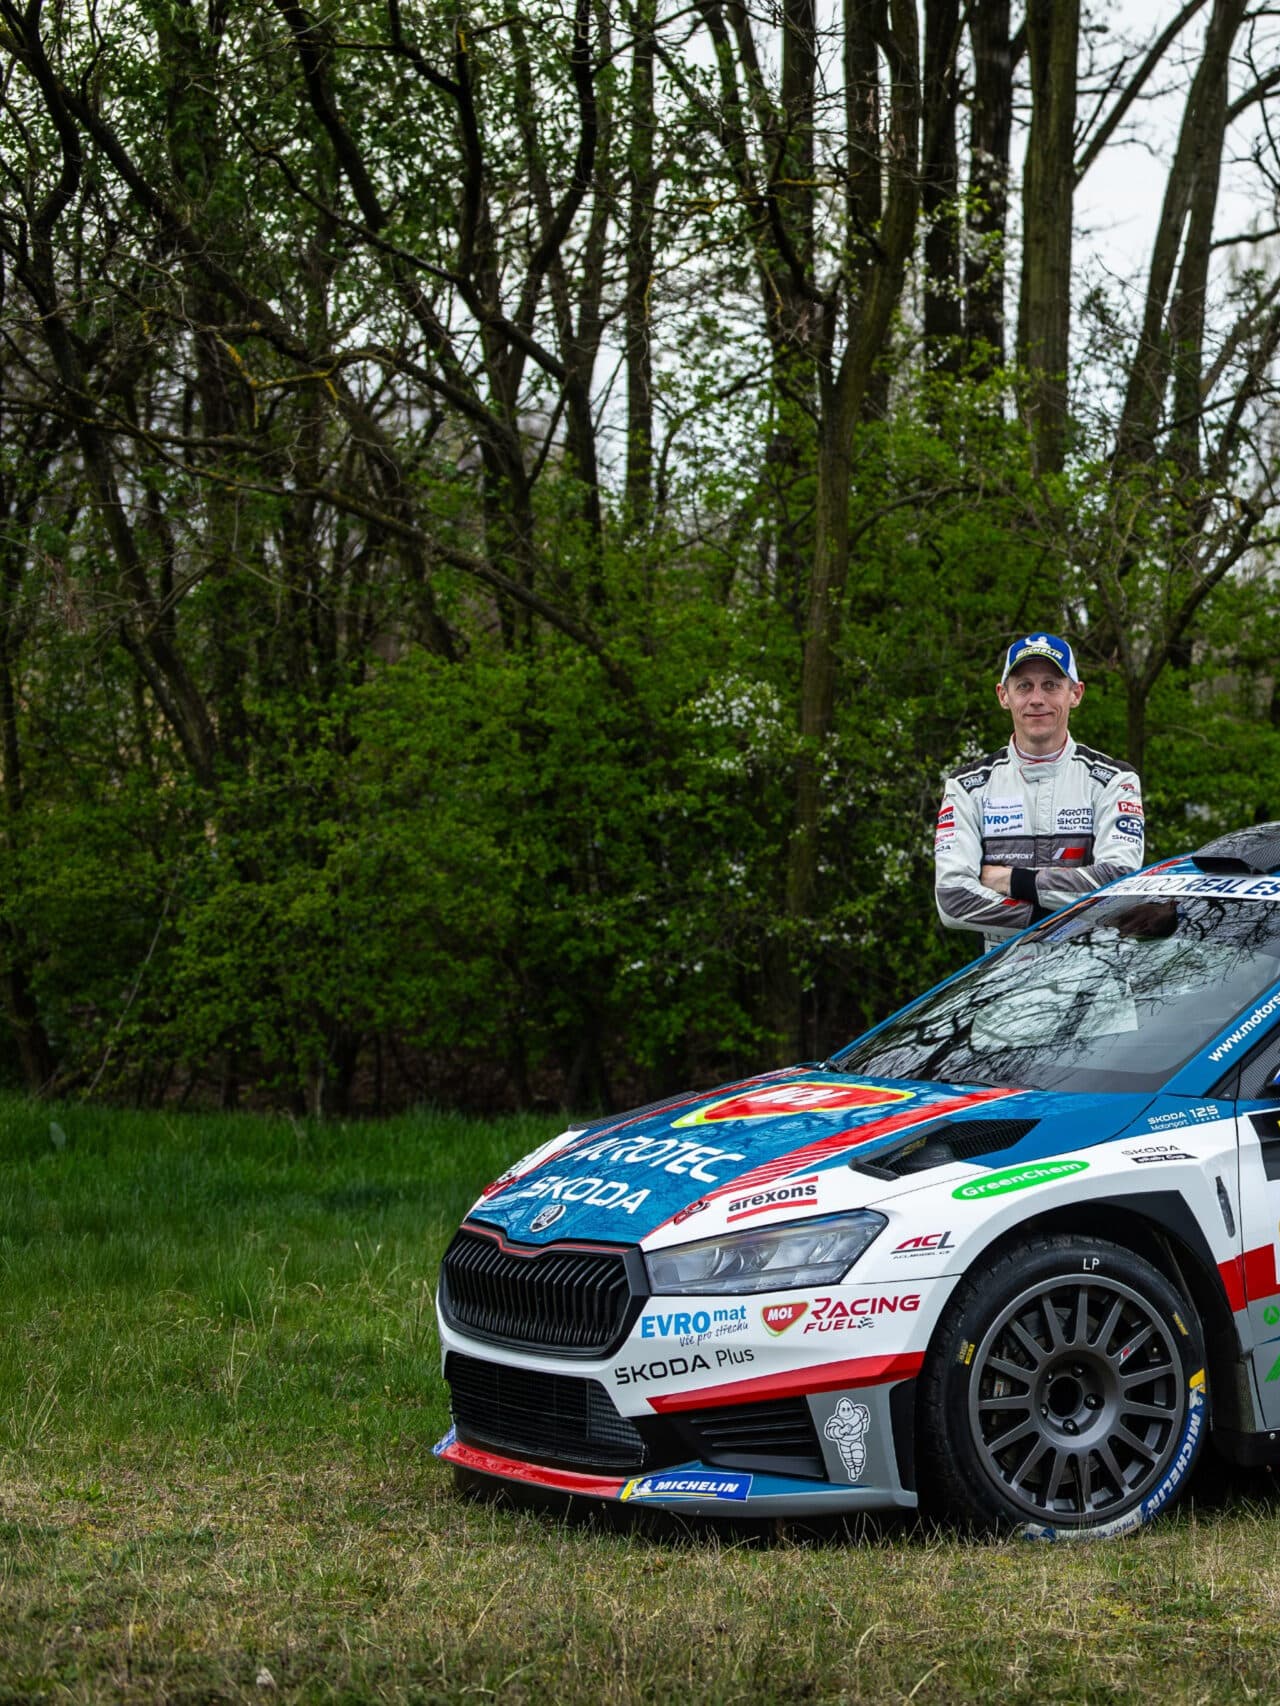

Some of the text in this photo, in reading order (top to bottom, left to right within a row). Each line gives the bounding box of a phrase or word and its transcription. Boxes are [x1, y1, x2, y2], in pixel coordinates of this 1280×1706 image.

[1181, 878, 1247, 893] REAL
[1189, 1104, 1219, 1119] 125
[961, 1161, 1082, 1197] GreenChem
[728, 1183, 817, 1212] arexons
[895, 1230, 956, 1250] ACL
[1083, 1258, 1100, 1271] LP
[767, 1294, 921, 1321] MOL RACING
[641, 1304, 747, 1338] EVRO mat
[696, 1331, 713, 1346] pro
[715, 1347, 755, 1367] Plus
[1148, 1413, 1201, 1514] MICHELIN
[654, 1479, 740, 1494] MICHELIN
